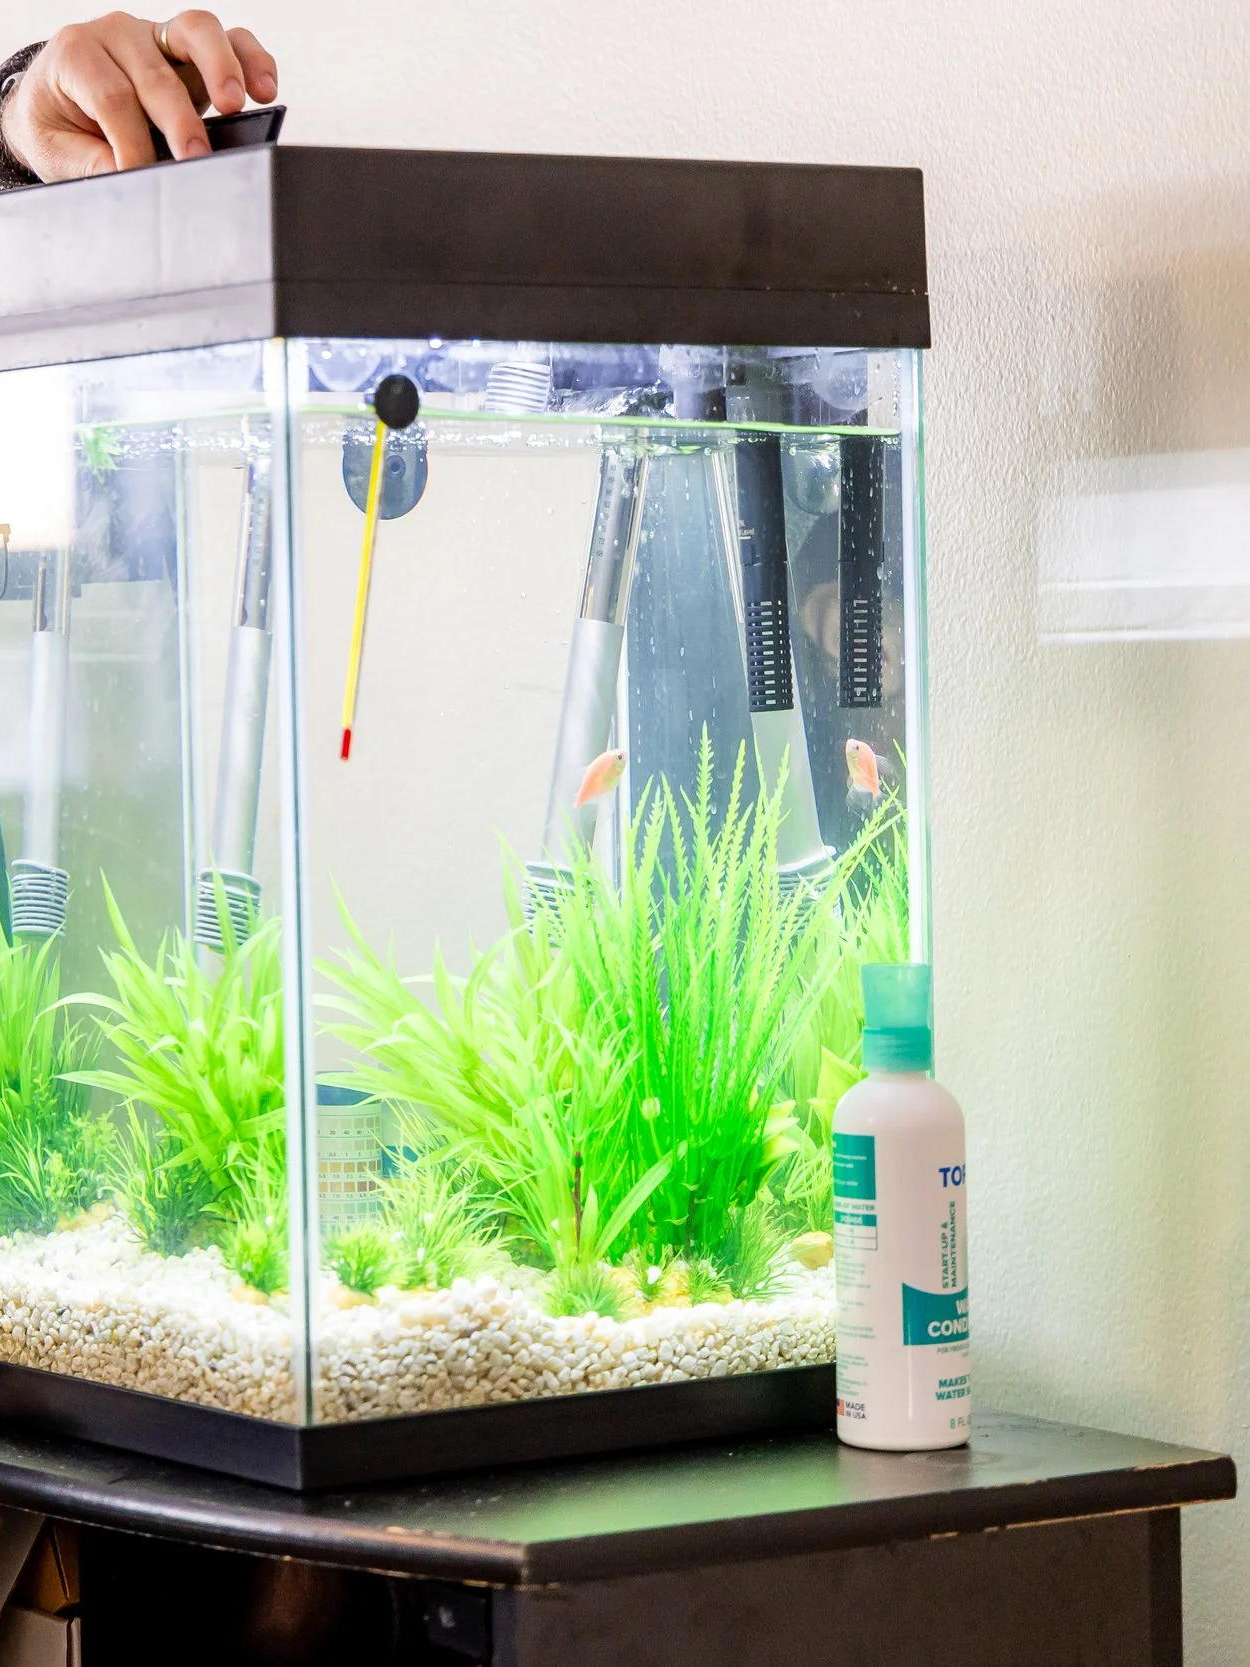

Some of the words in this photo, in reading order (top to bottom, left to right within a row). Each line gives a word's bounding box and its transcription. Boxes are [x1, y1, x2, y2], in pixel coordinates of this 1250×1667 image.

[941, 1221, 948, 1229] &
[941, 1232, 949, 1289] START-UP
[939, 1376, 967, 1388] MAKES
[934, 1388, 965, 1400] WATER
[845, 1401, 866, 1411] MADE
[845, 1410, 851, 1418] IN
[852, 1412, 867, 1420] USA
[950, 1418, 956, 1429] 8
